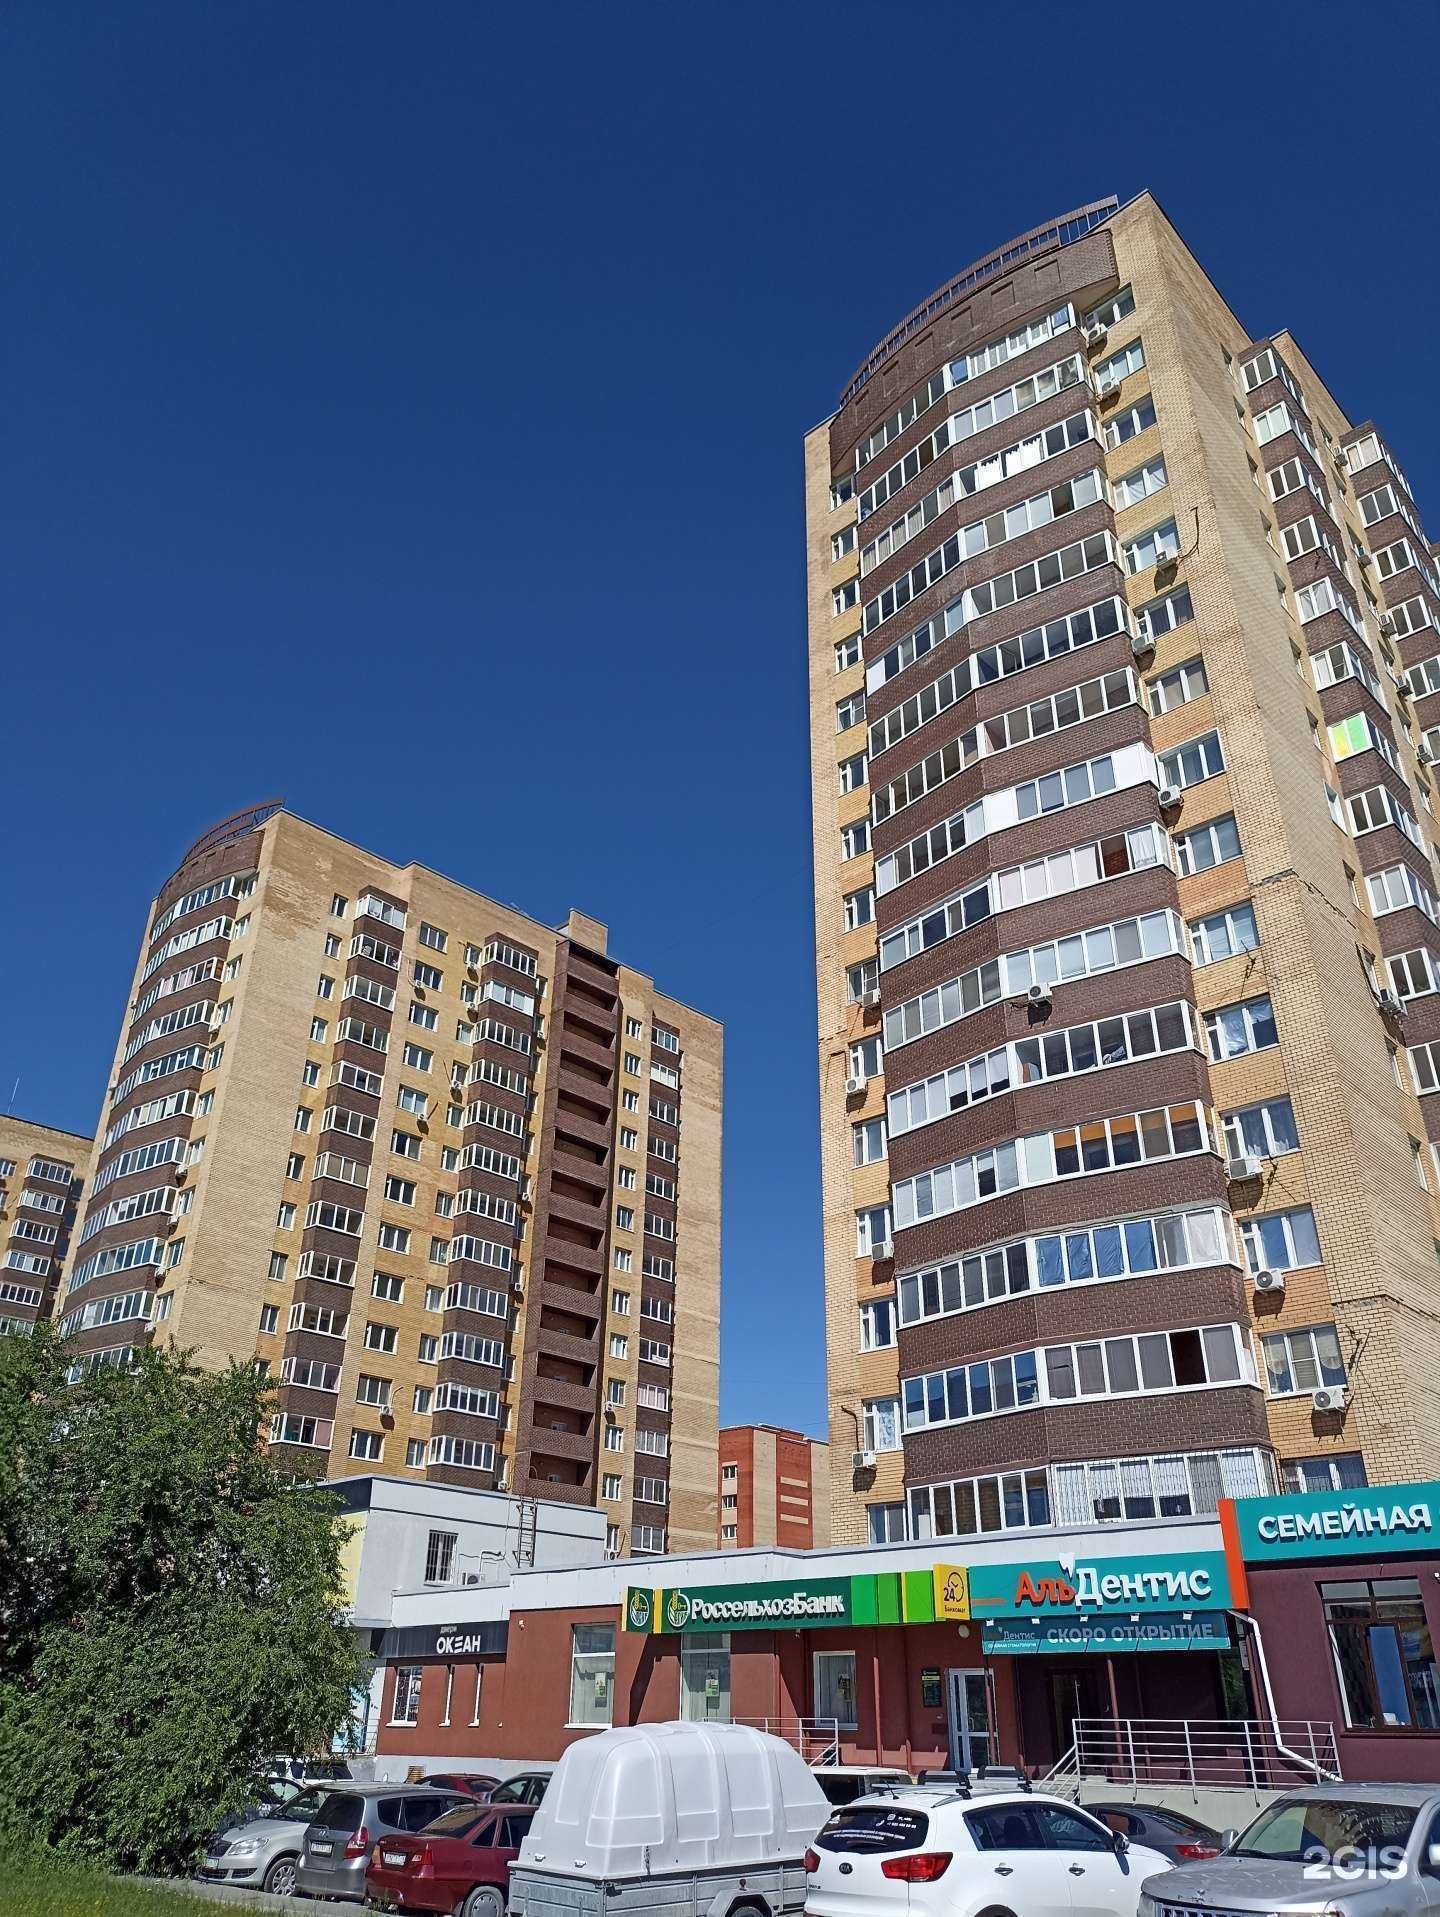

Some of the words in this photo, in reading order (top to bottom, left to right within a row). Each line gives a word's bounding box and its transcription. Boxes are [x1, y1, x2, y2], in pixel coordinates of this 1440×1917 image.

[1258, 1503, 1432, 1539] СЕМЕЙНАЯ
[943, 1587, 956, 1602] 24
[691, 1592, 845, 1620] РоссельхозБанк
[436, 1634, 481, 1654] ОКЕАН
[1046, 1627, 1107, 1644] СКОРО
[1111, 1623, 1214, 1643] ОТКРЫТИЕ
